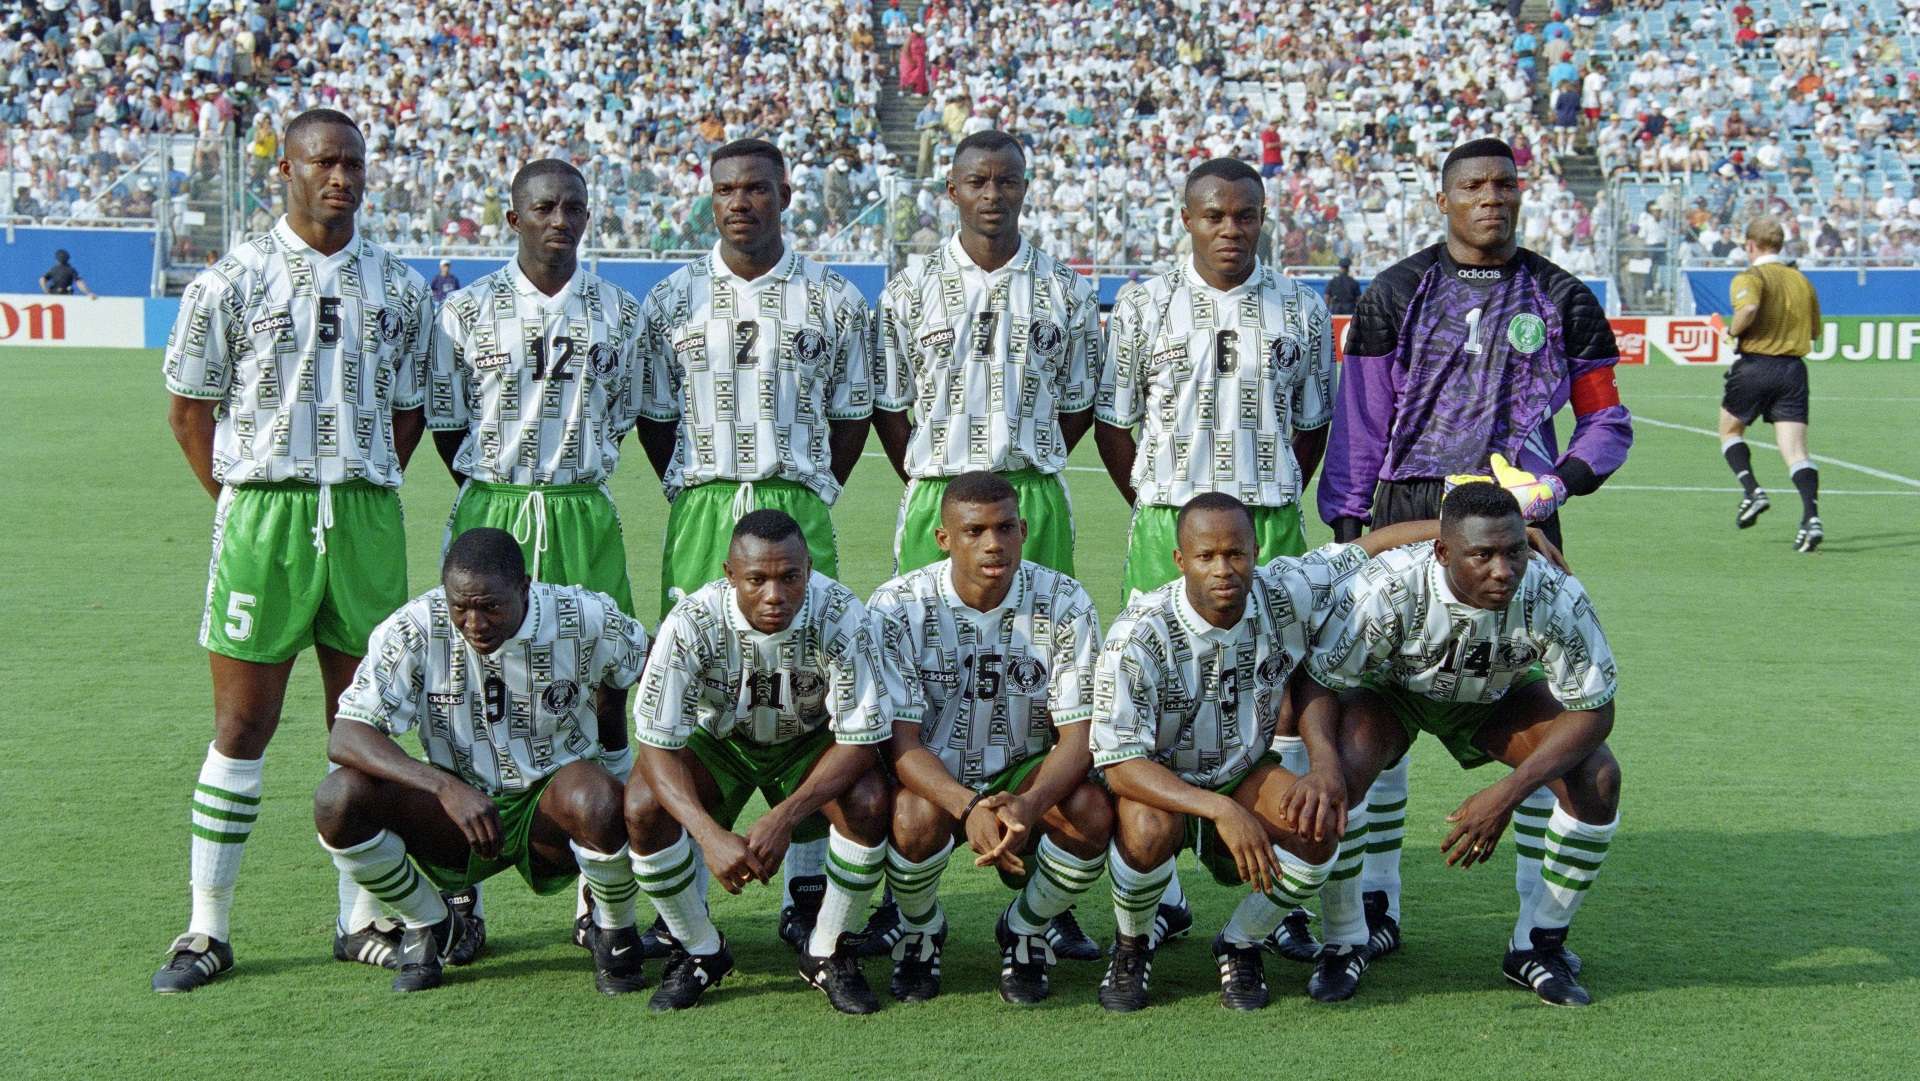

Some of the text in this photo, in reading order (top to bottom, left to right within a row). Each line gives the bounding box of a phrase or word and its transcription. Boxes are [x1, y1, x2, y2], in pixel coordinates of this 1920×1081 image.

[1458, 268, 1501, 279] adidas
[254, 316, 292, 332] adidas
[317, 297, 344, 345] 5
[922, 330, 954, 347] adidas
[979, 311, 1000, 356] 7
[1463, 308, 1482, 355] 1
[477, 354, 511, 368] adidas
[530, 336, 575, 382] 12
[676, 336, 705, 353] adidas
[736, 320, 760, 365] 2
[1154, 348, 1187, 364] adidas
[1216, 329, 1241, 373] 6
[224, 590, 257, 641] 5
[921, 671, 955, 682] adidas
[963, 654, 1003, 700] 15
[1437, 639, 1493, 678] 14
[428, 694, 464, 704] adidas
[484, 677, 507, 723] 9
[745, 672, 786, 711] 11
[1220, 666, 1239, 714] 3
